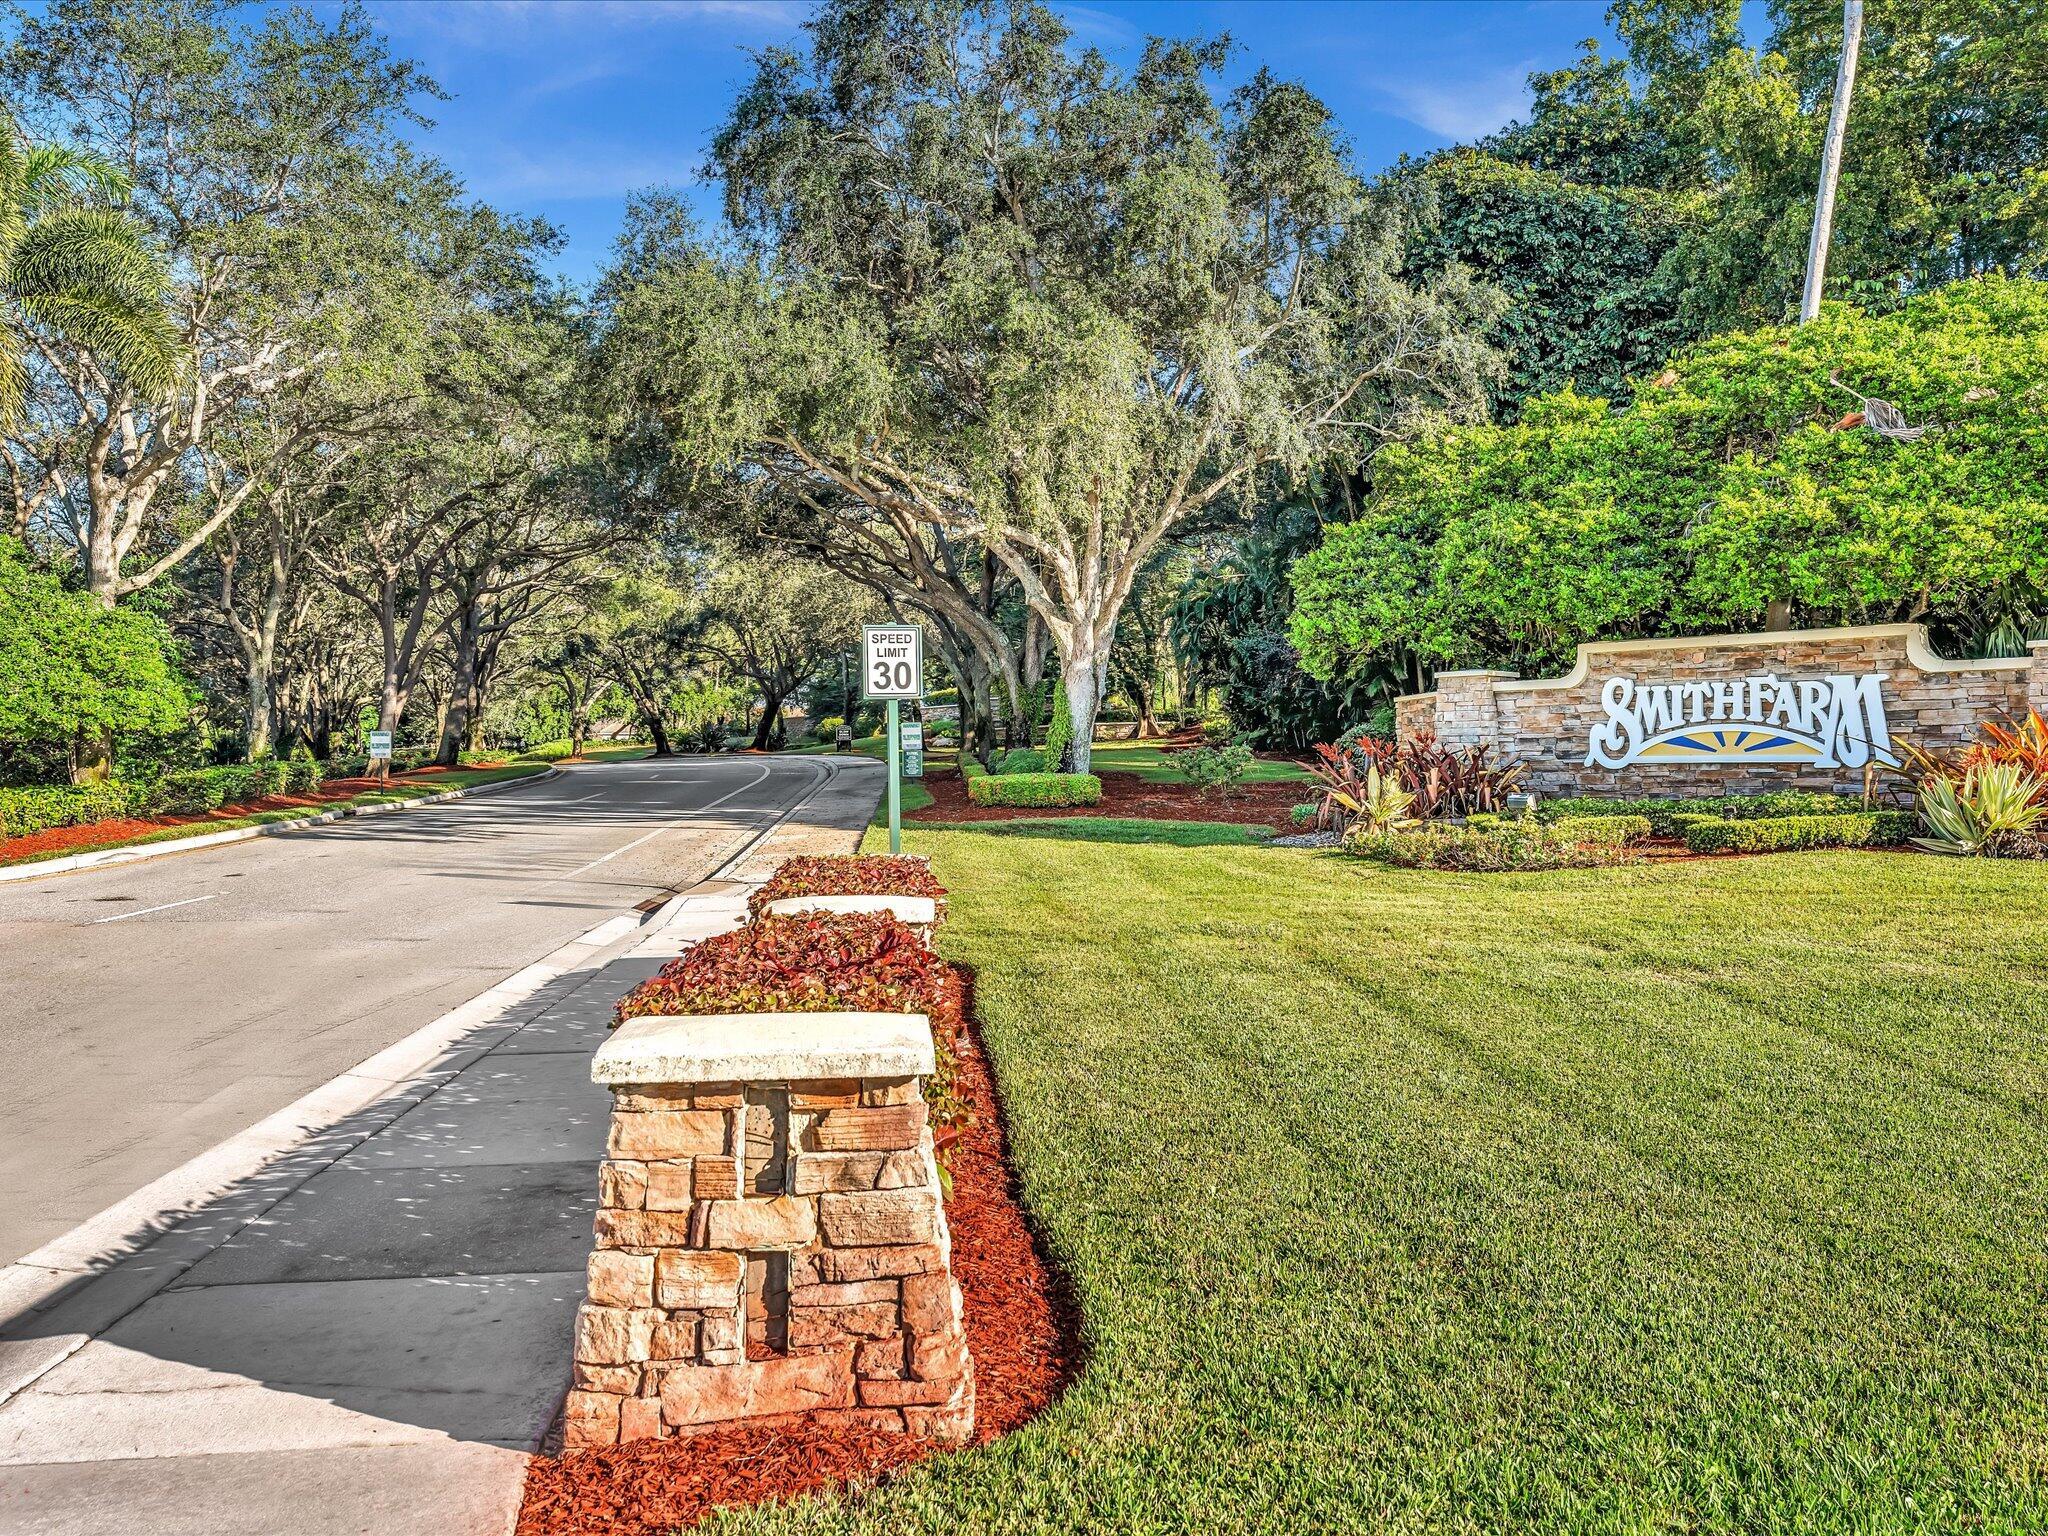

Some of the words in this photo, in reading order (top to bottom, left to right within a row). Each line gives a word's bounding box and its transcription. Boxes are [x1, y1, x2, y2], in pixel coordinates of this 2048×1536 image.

[871, 633, 912, 644] SPEED
[876, 647, 908, 658] LIMIT
[873, 661, 912, 690] 30
